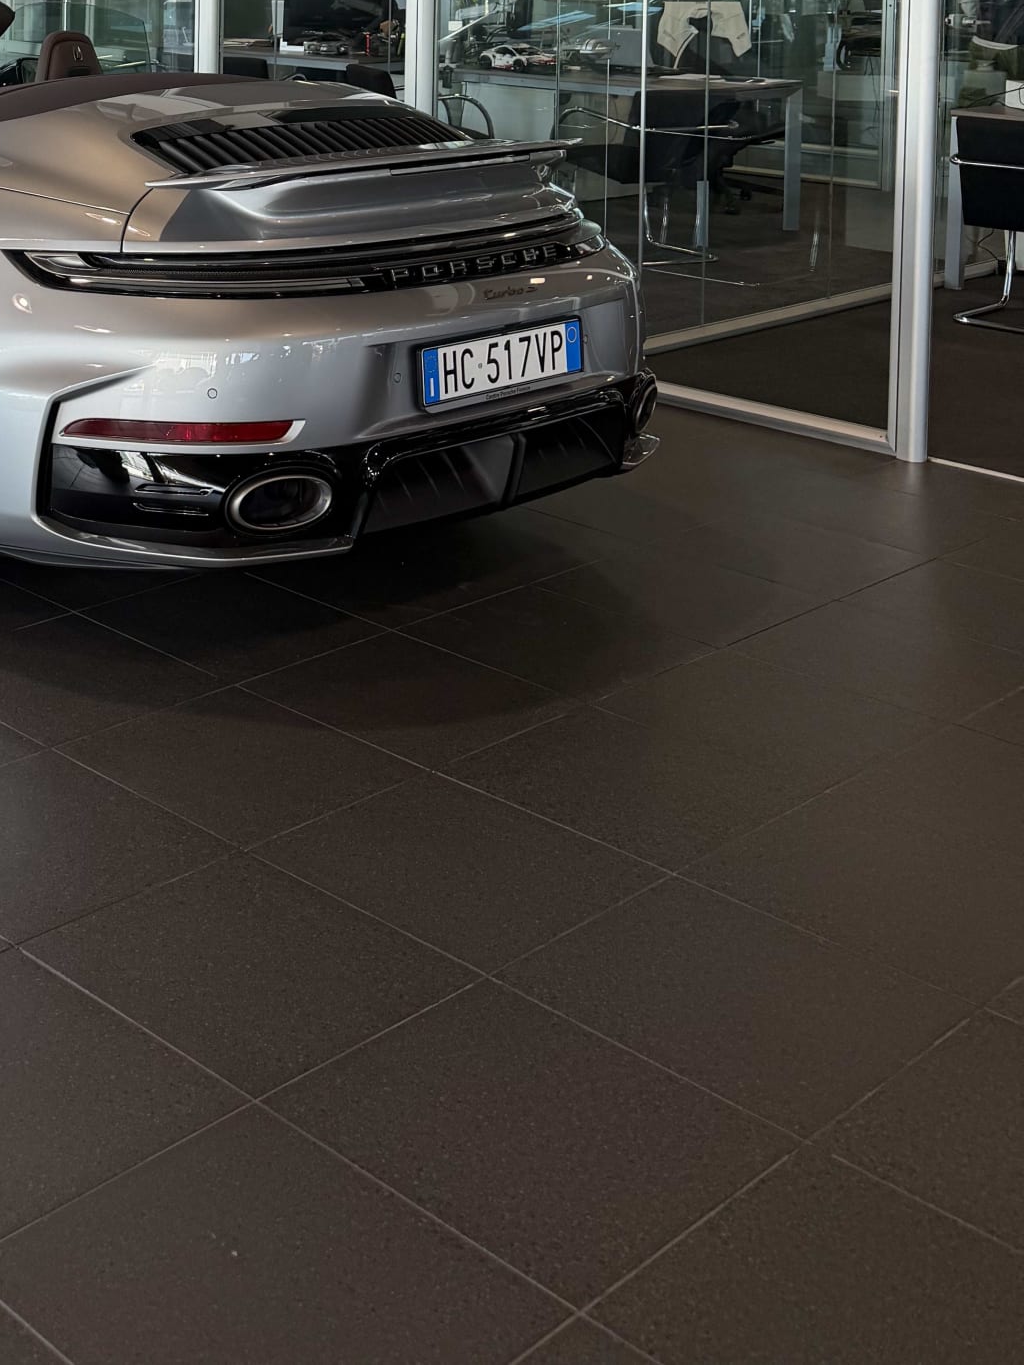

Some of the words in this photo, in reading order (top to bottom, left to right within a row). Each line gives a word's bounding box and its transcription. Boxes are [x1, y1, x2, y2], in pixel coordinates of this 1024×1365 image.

[391, 244, 557, 282] PORSCHE
[442, 348, 475, 395] HC
[486, 330, 563, 384] 517VP
